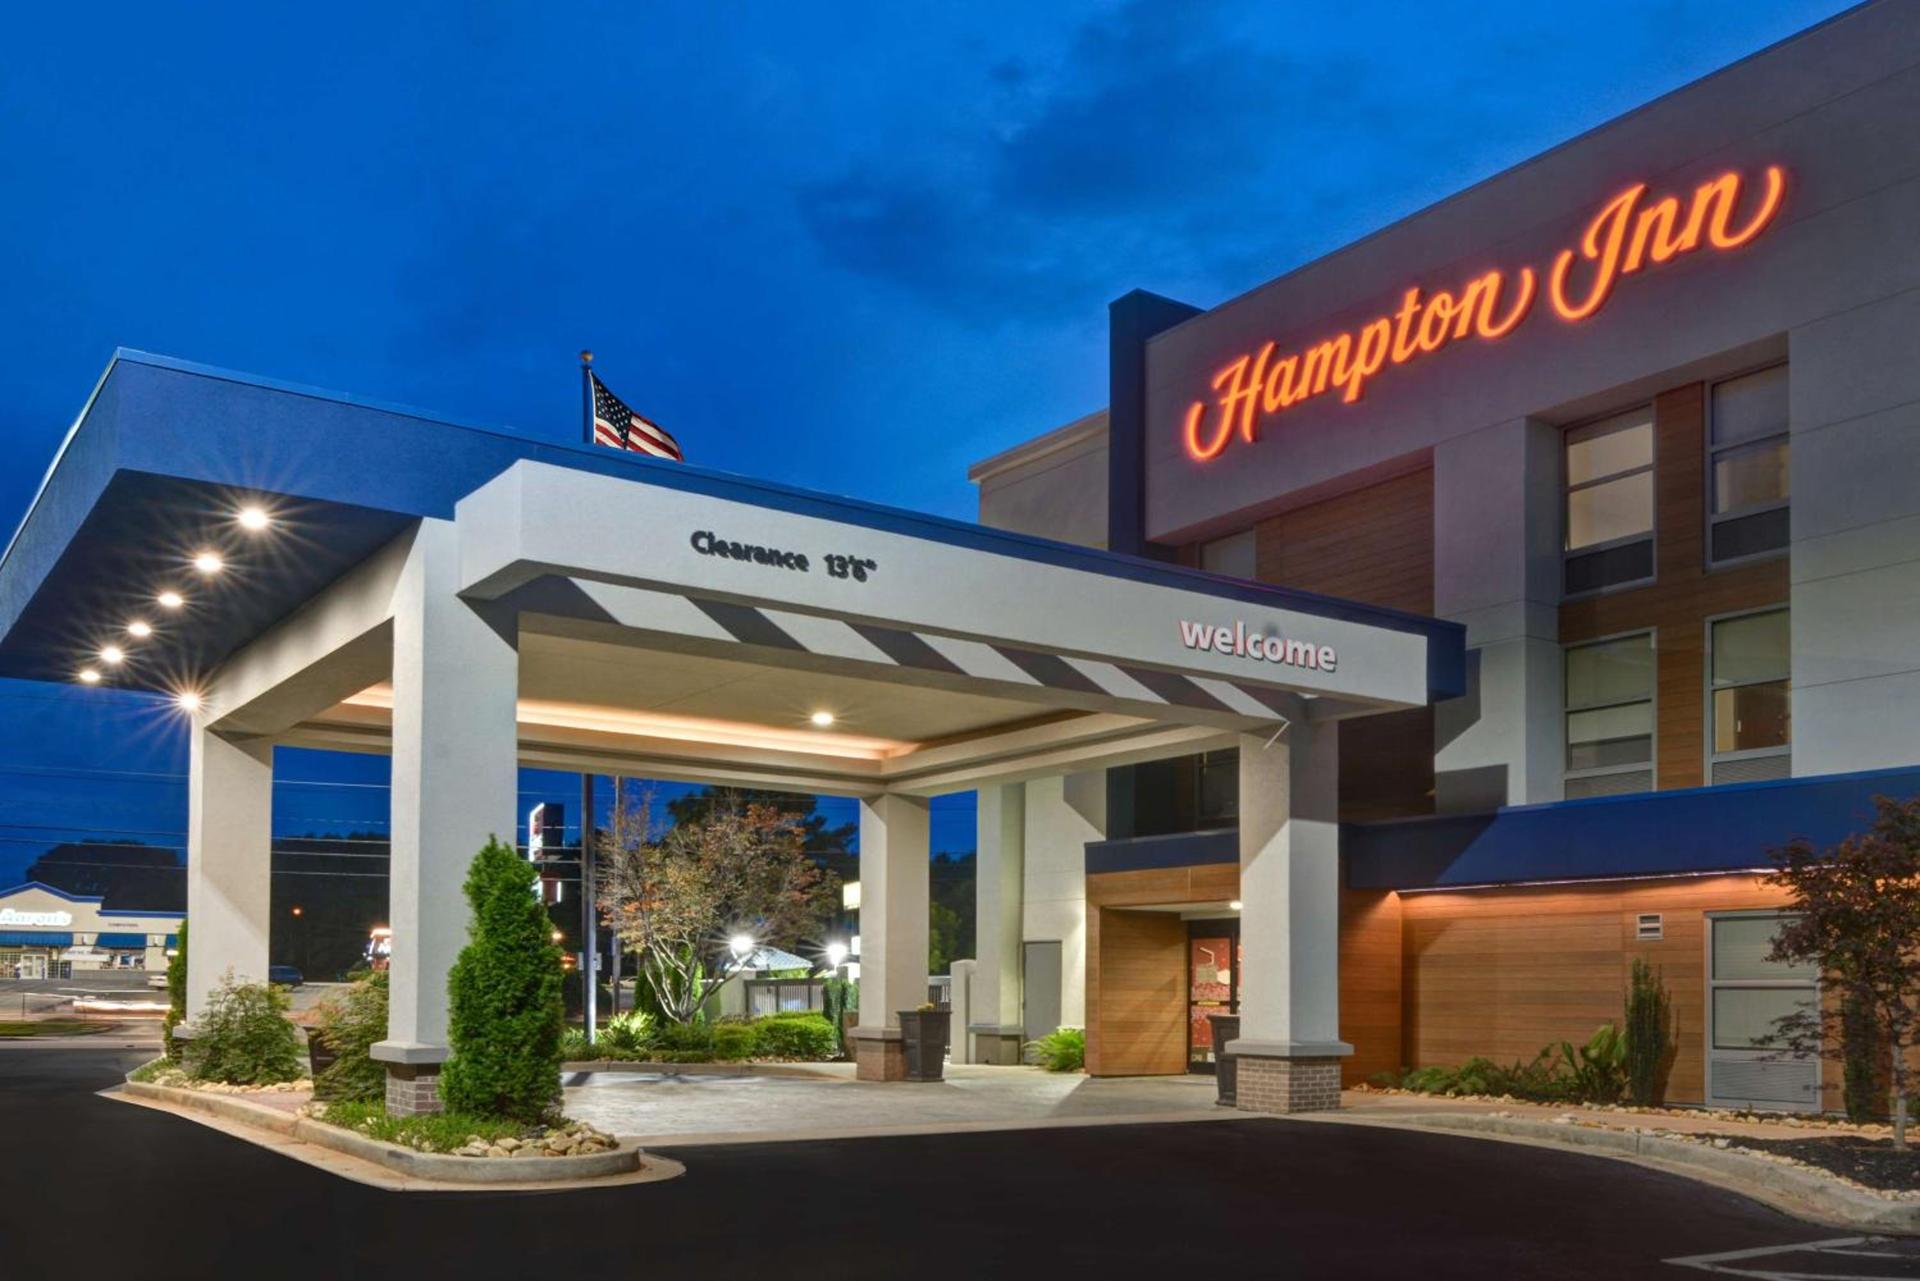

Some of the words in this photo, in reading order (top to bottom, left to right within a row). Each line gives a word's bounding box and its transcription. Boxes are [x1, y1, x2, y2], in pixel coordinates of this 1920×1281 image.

[1184, 267, 1536, 461] Hampton
[1550, 165, 1787, 321] Inn
[690, 530, 810, 572] Clearance
[1180, 620, 1338, 673] welcome
